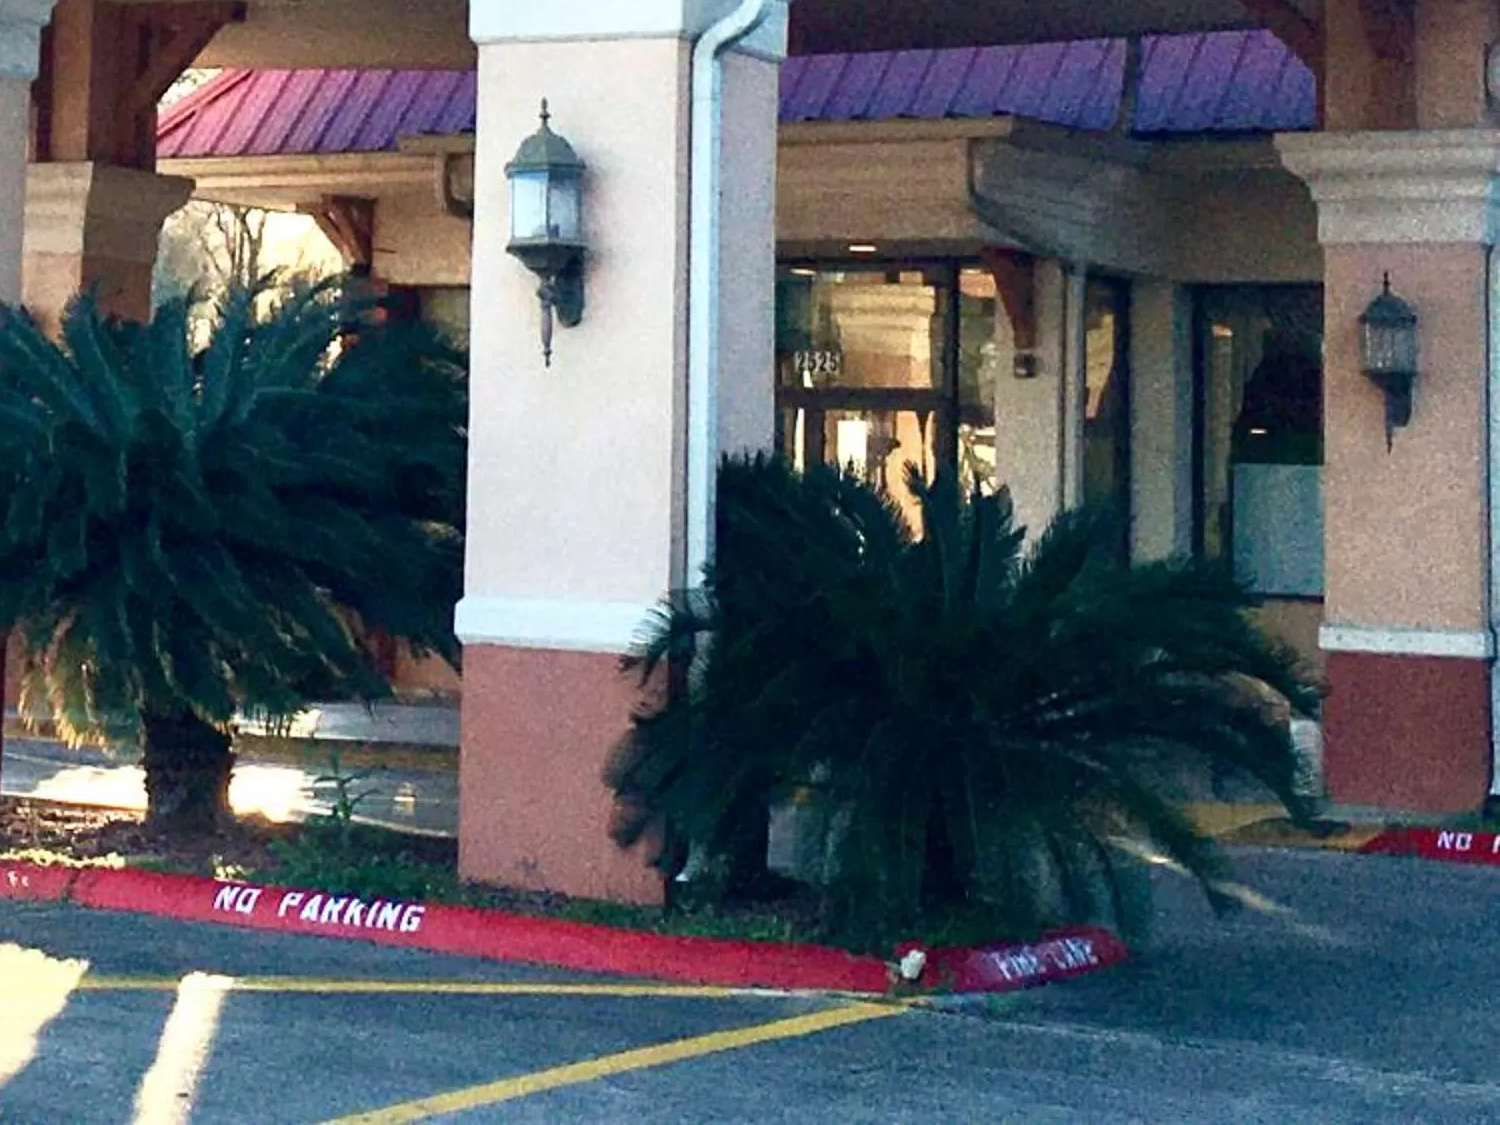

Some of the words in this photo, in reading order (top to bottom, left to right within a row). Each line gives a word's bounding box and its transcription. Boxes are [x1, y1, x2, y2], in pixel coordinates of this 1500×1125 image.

[1437, 830, 1473, 851] NO
[213, 886, 262, 914] NO
[277, 891, 425, 932] PARKING
